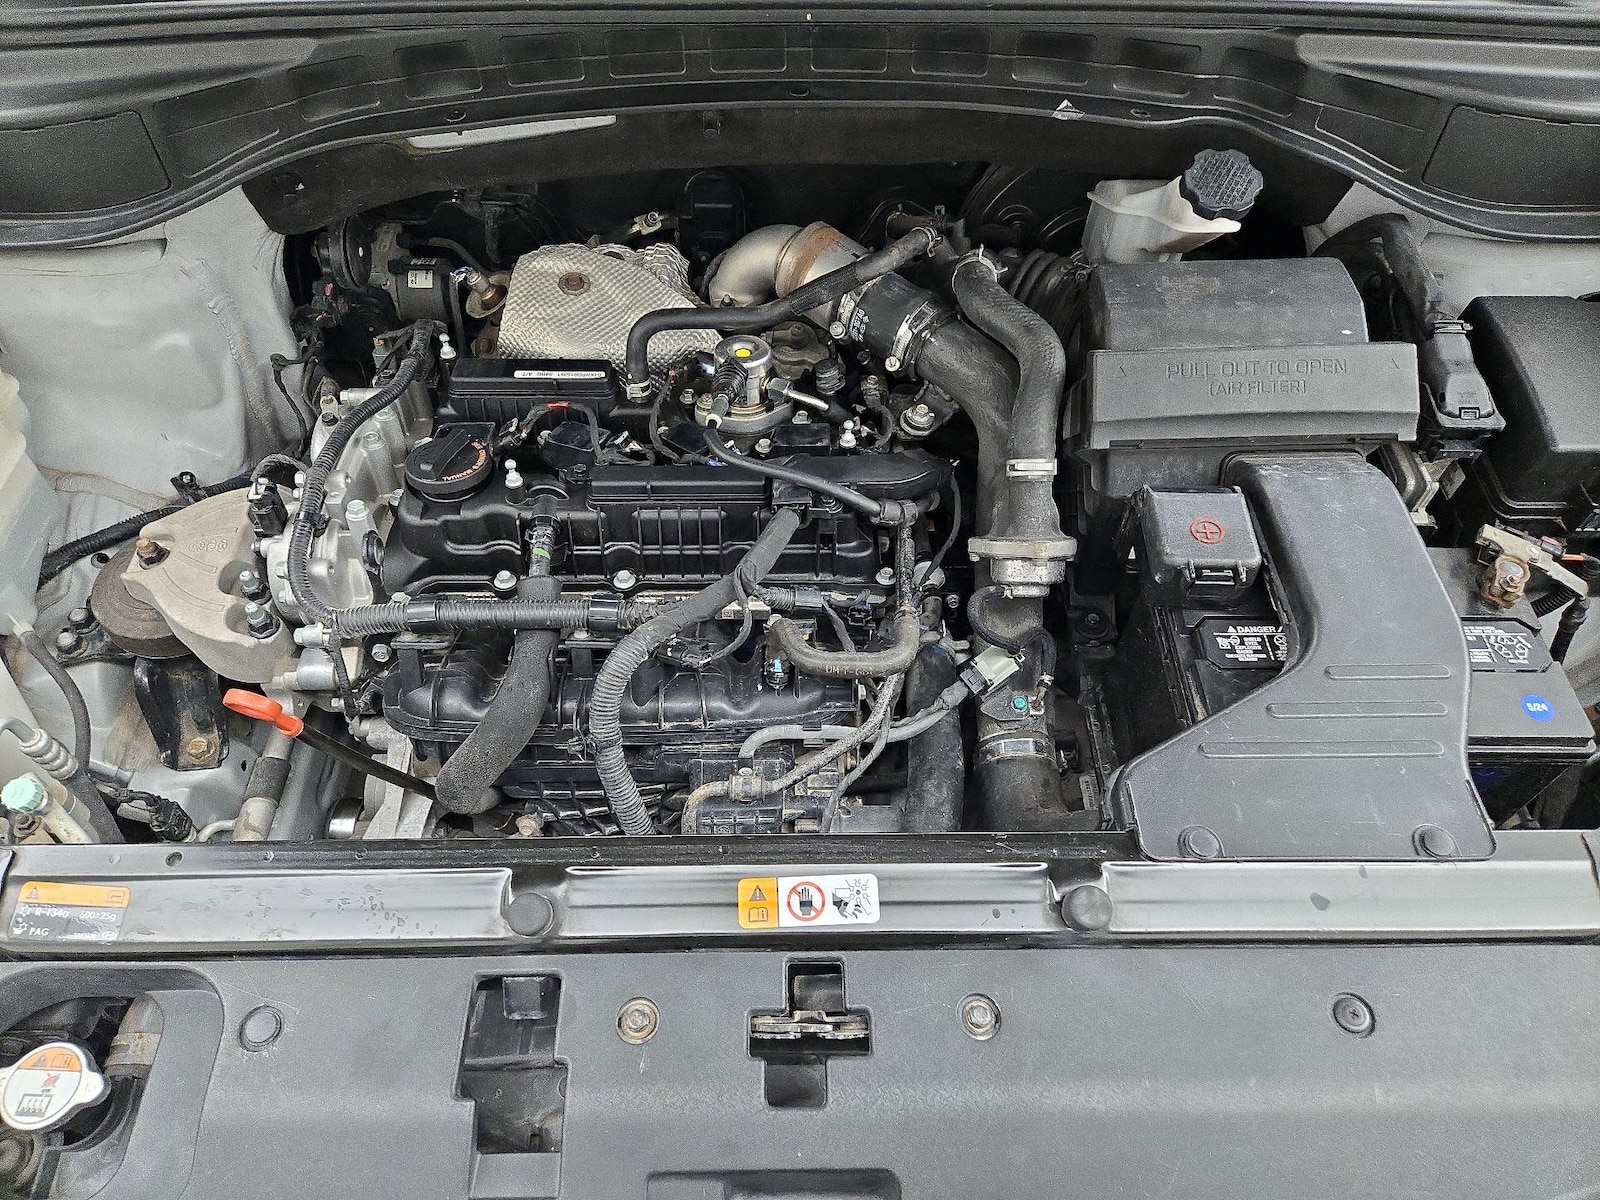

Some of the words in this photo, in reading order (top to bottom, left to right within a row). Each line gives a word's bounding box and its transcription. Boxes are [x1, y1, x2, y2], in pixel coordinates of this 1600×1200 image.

[1166, 362, 1215, 379] PULL
[1220, 360, 1259, 377] OUT
[1265, 359, 1290, 375] TO
[1295, 358, 1347, 375] OPEN
[442, 469, 473, 480] MANUAL
[29, 928, 49, 936] PAG
